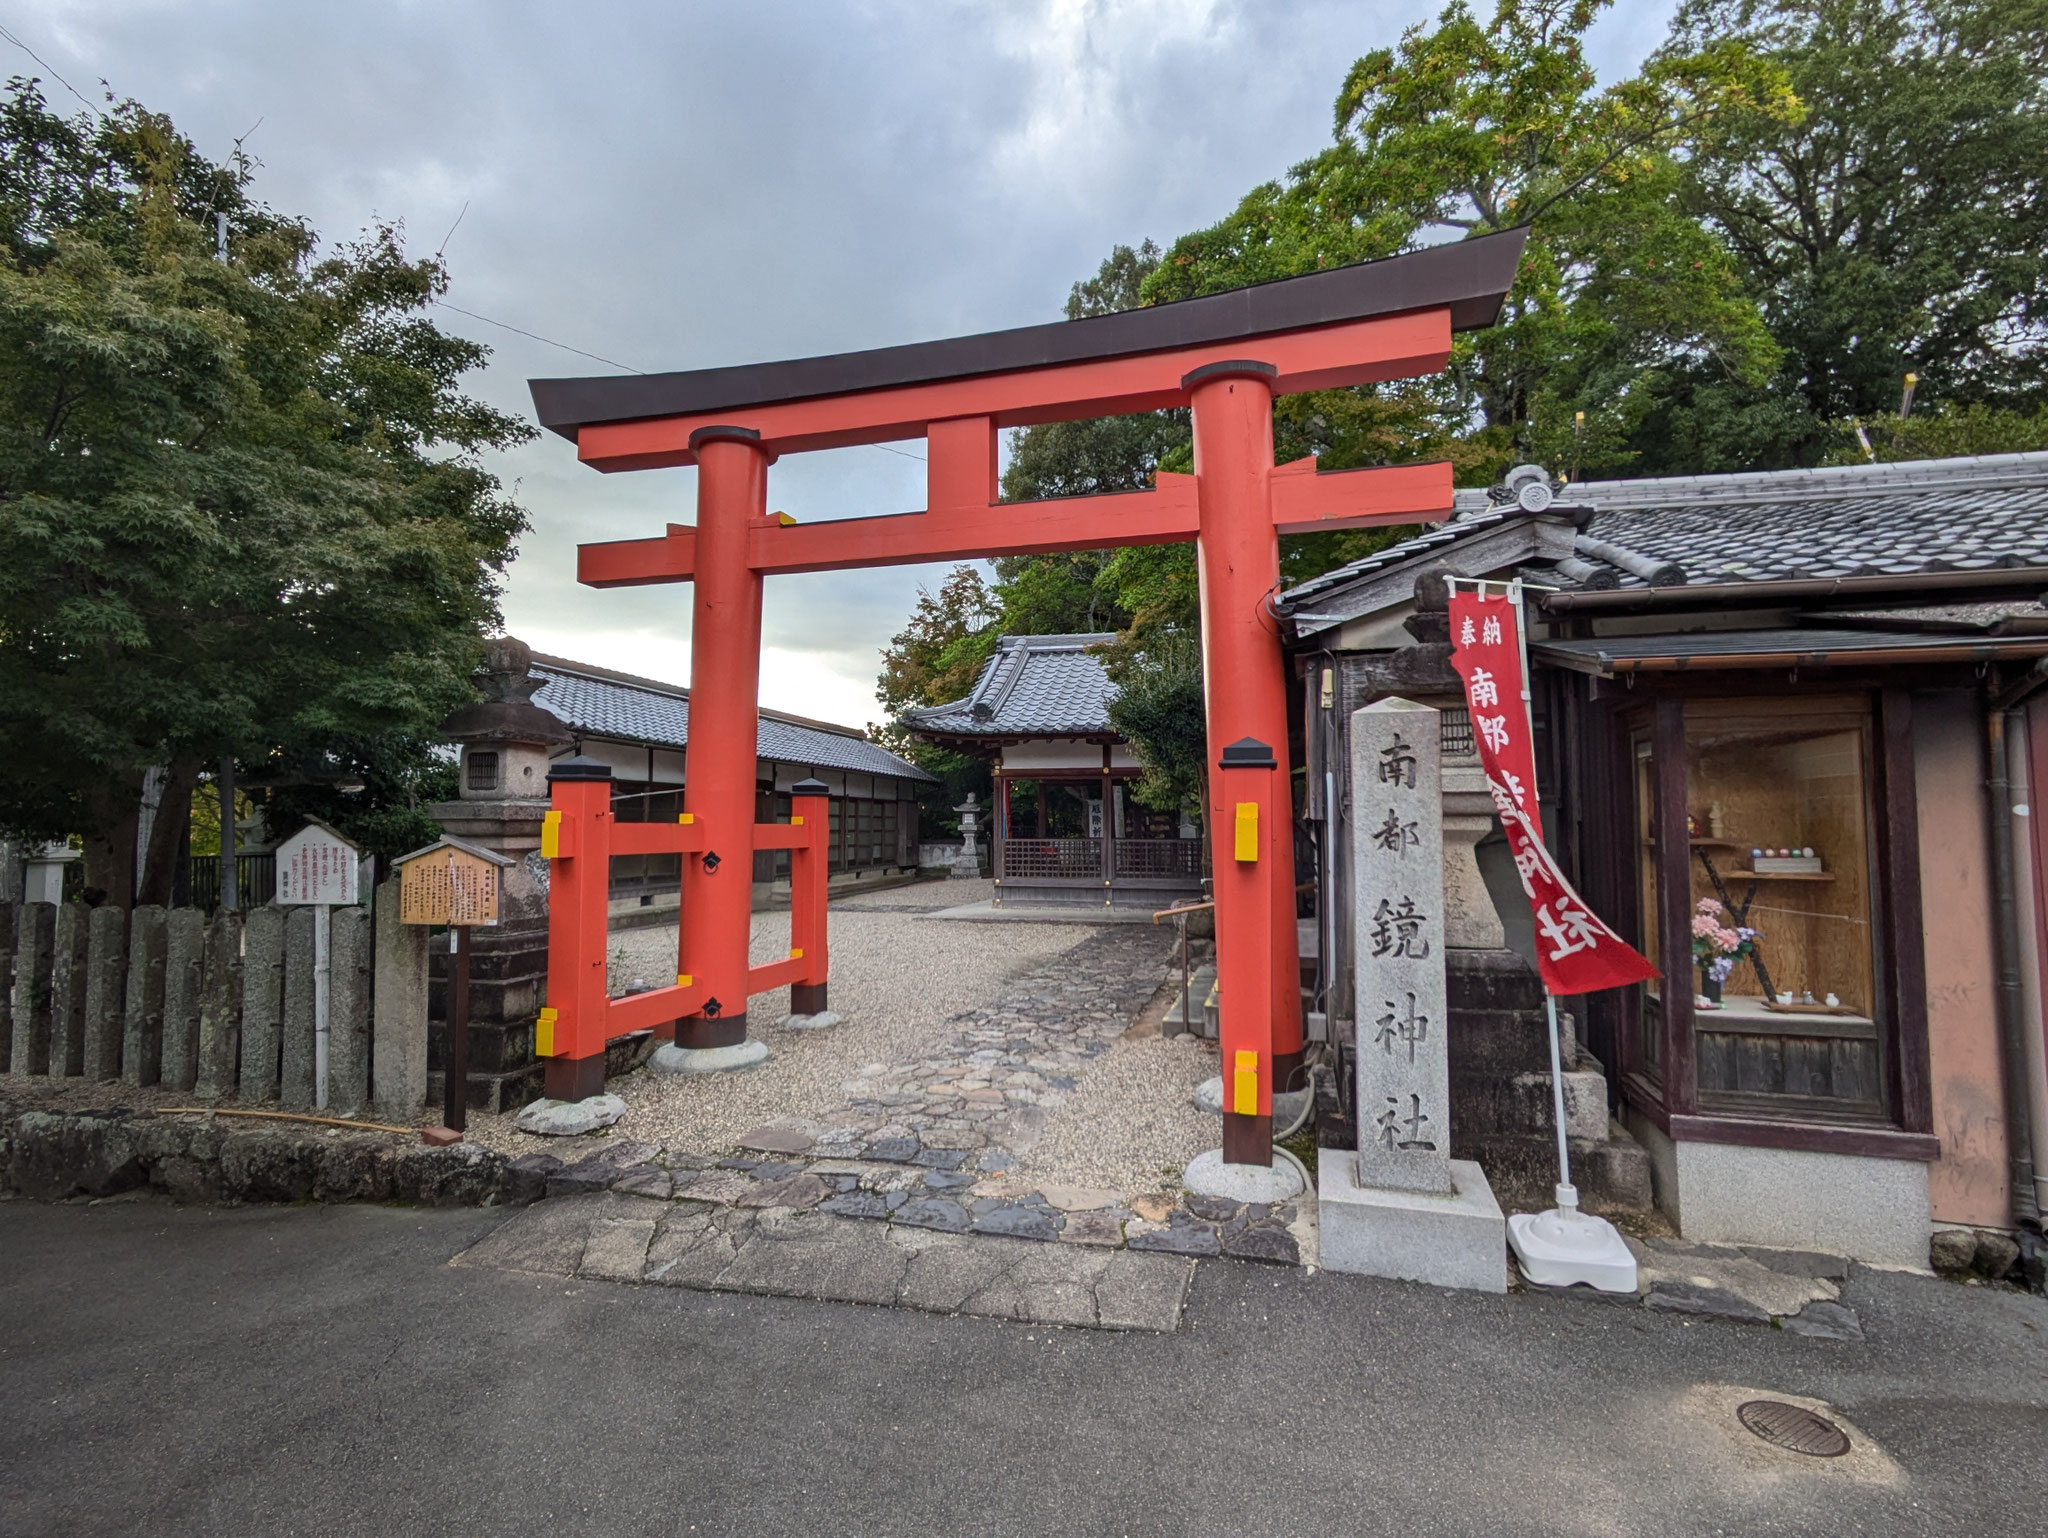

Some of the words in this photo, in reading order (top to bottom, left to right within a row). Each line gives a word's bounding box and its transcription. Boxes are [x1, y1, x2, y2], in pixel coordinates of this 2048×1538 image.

[1460, 616, 1502, 649] 奉納
[1370, 732, 1437, 1153] 南都鏡神社
